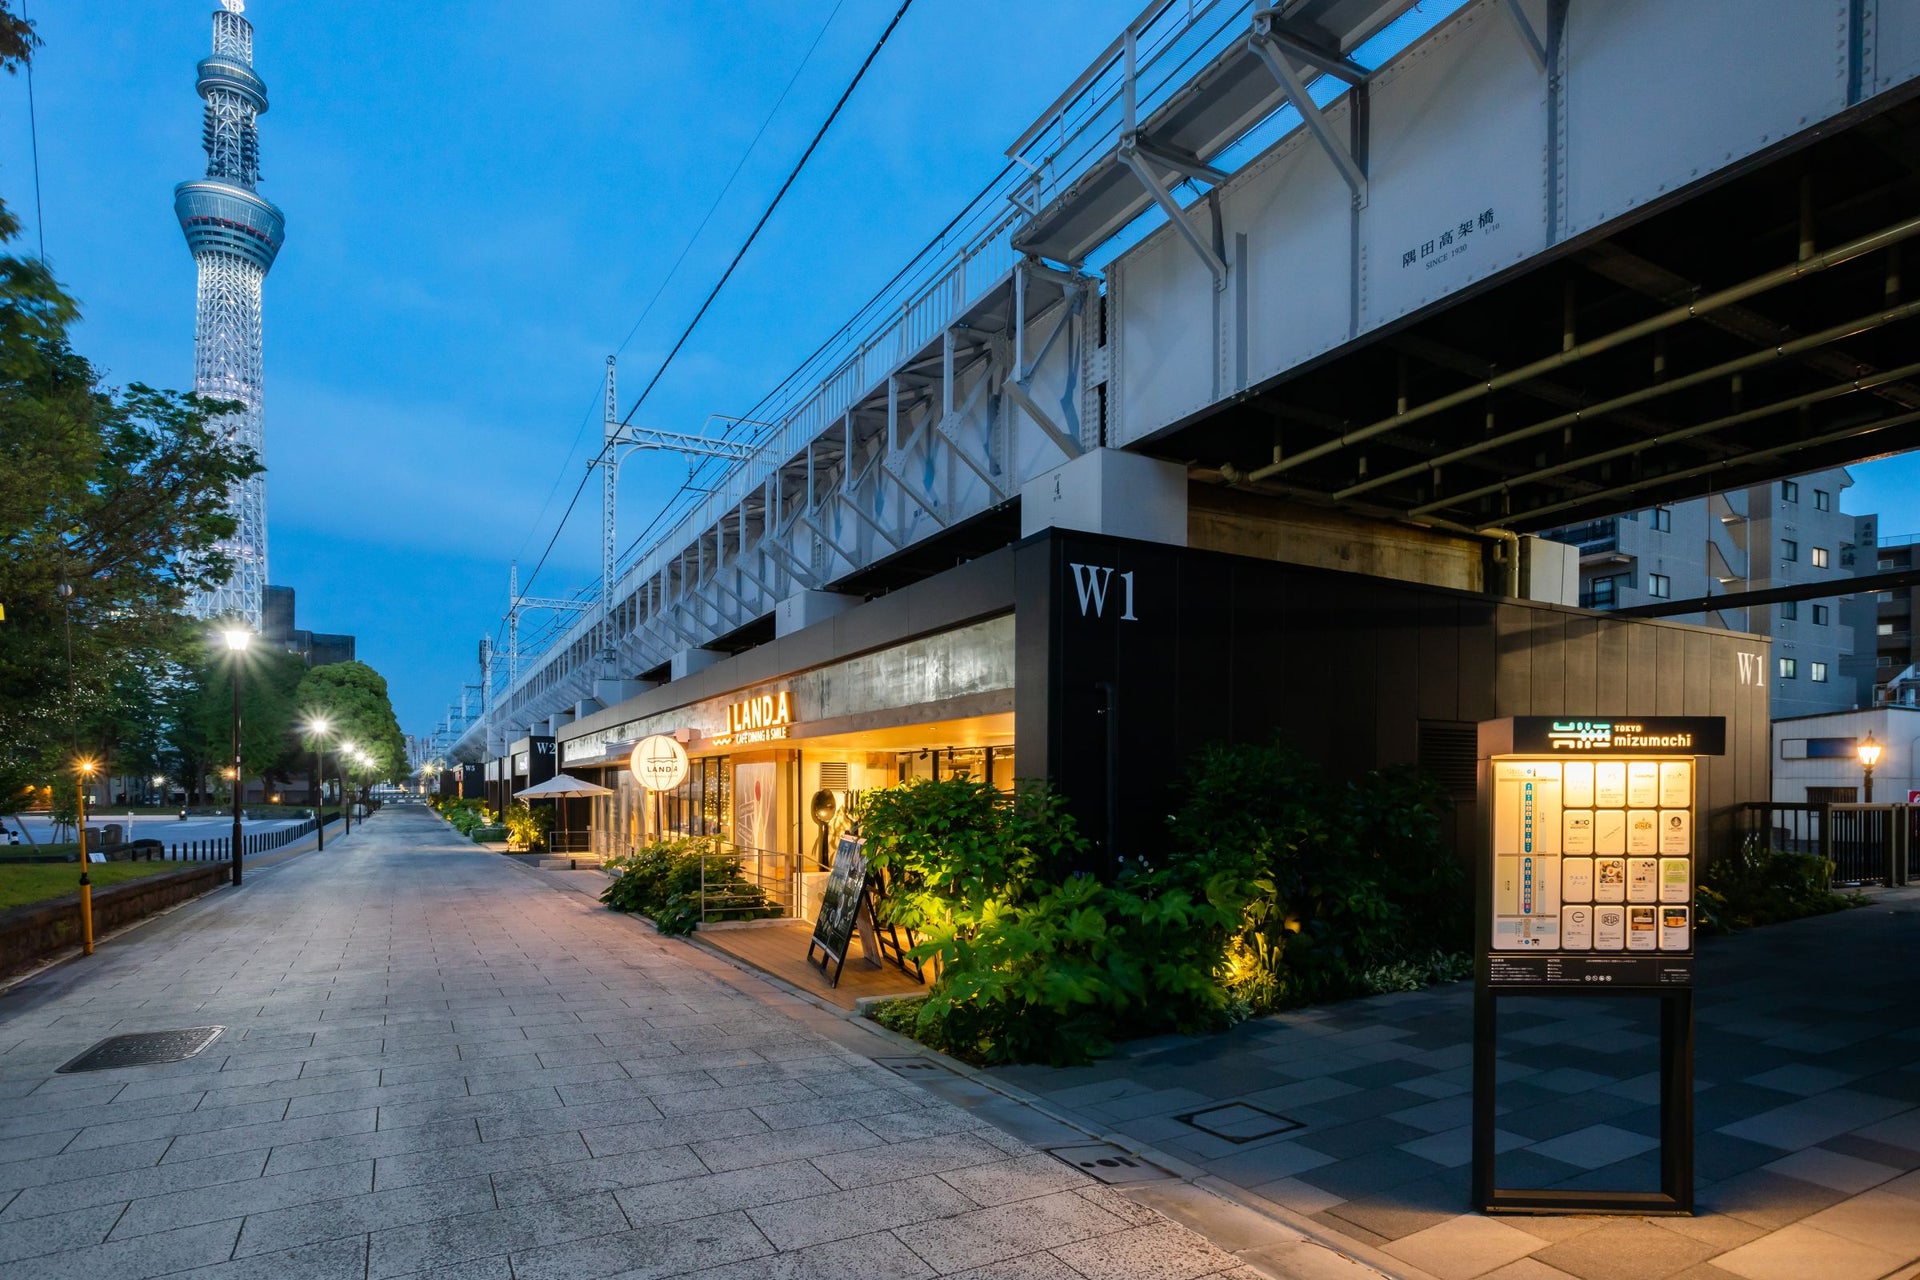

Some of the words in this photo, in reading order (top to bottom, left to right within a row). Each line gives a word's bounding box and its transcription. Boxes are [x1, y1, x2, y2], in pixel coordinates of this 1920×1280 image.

[1402, 207, 1494, 269] 隅田高架橋
[1426, 253, 1448, 271] SINCE
[1451, 243, 1467, 257] 1930
[1069, 562, 1139, 621] W1
[1737, 652, 1764, 687] W1
[537, 742, 556, 755] W2
[1614, 734, 1691, 747] mizumachi
